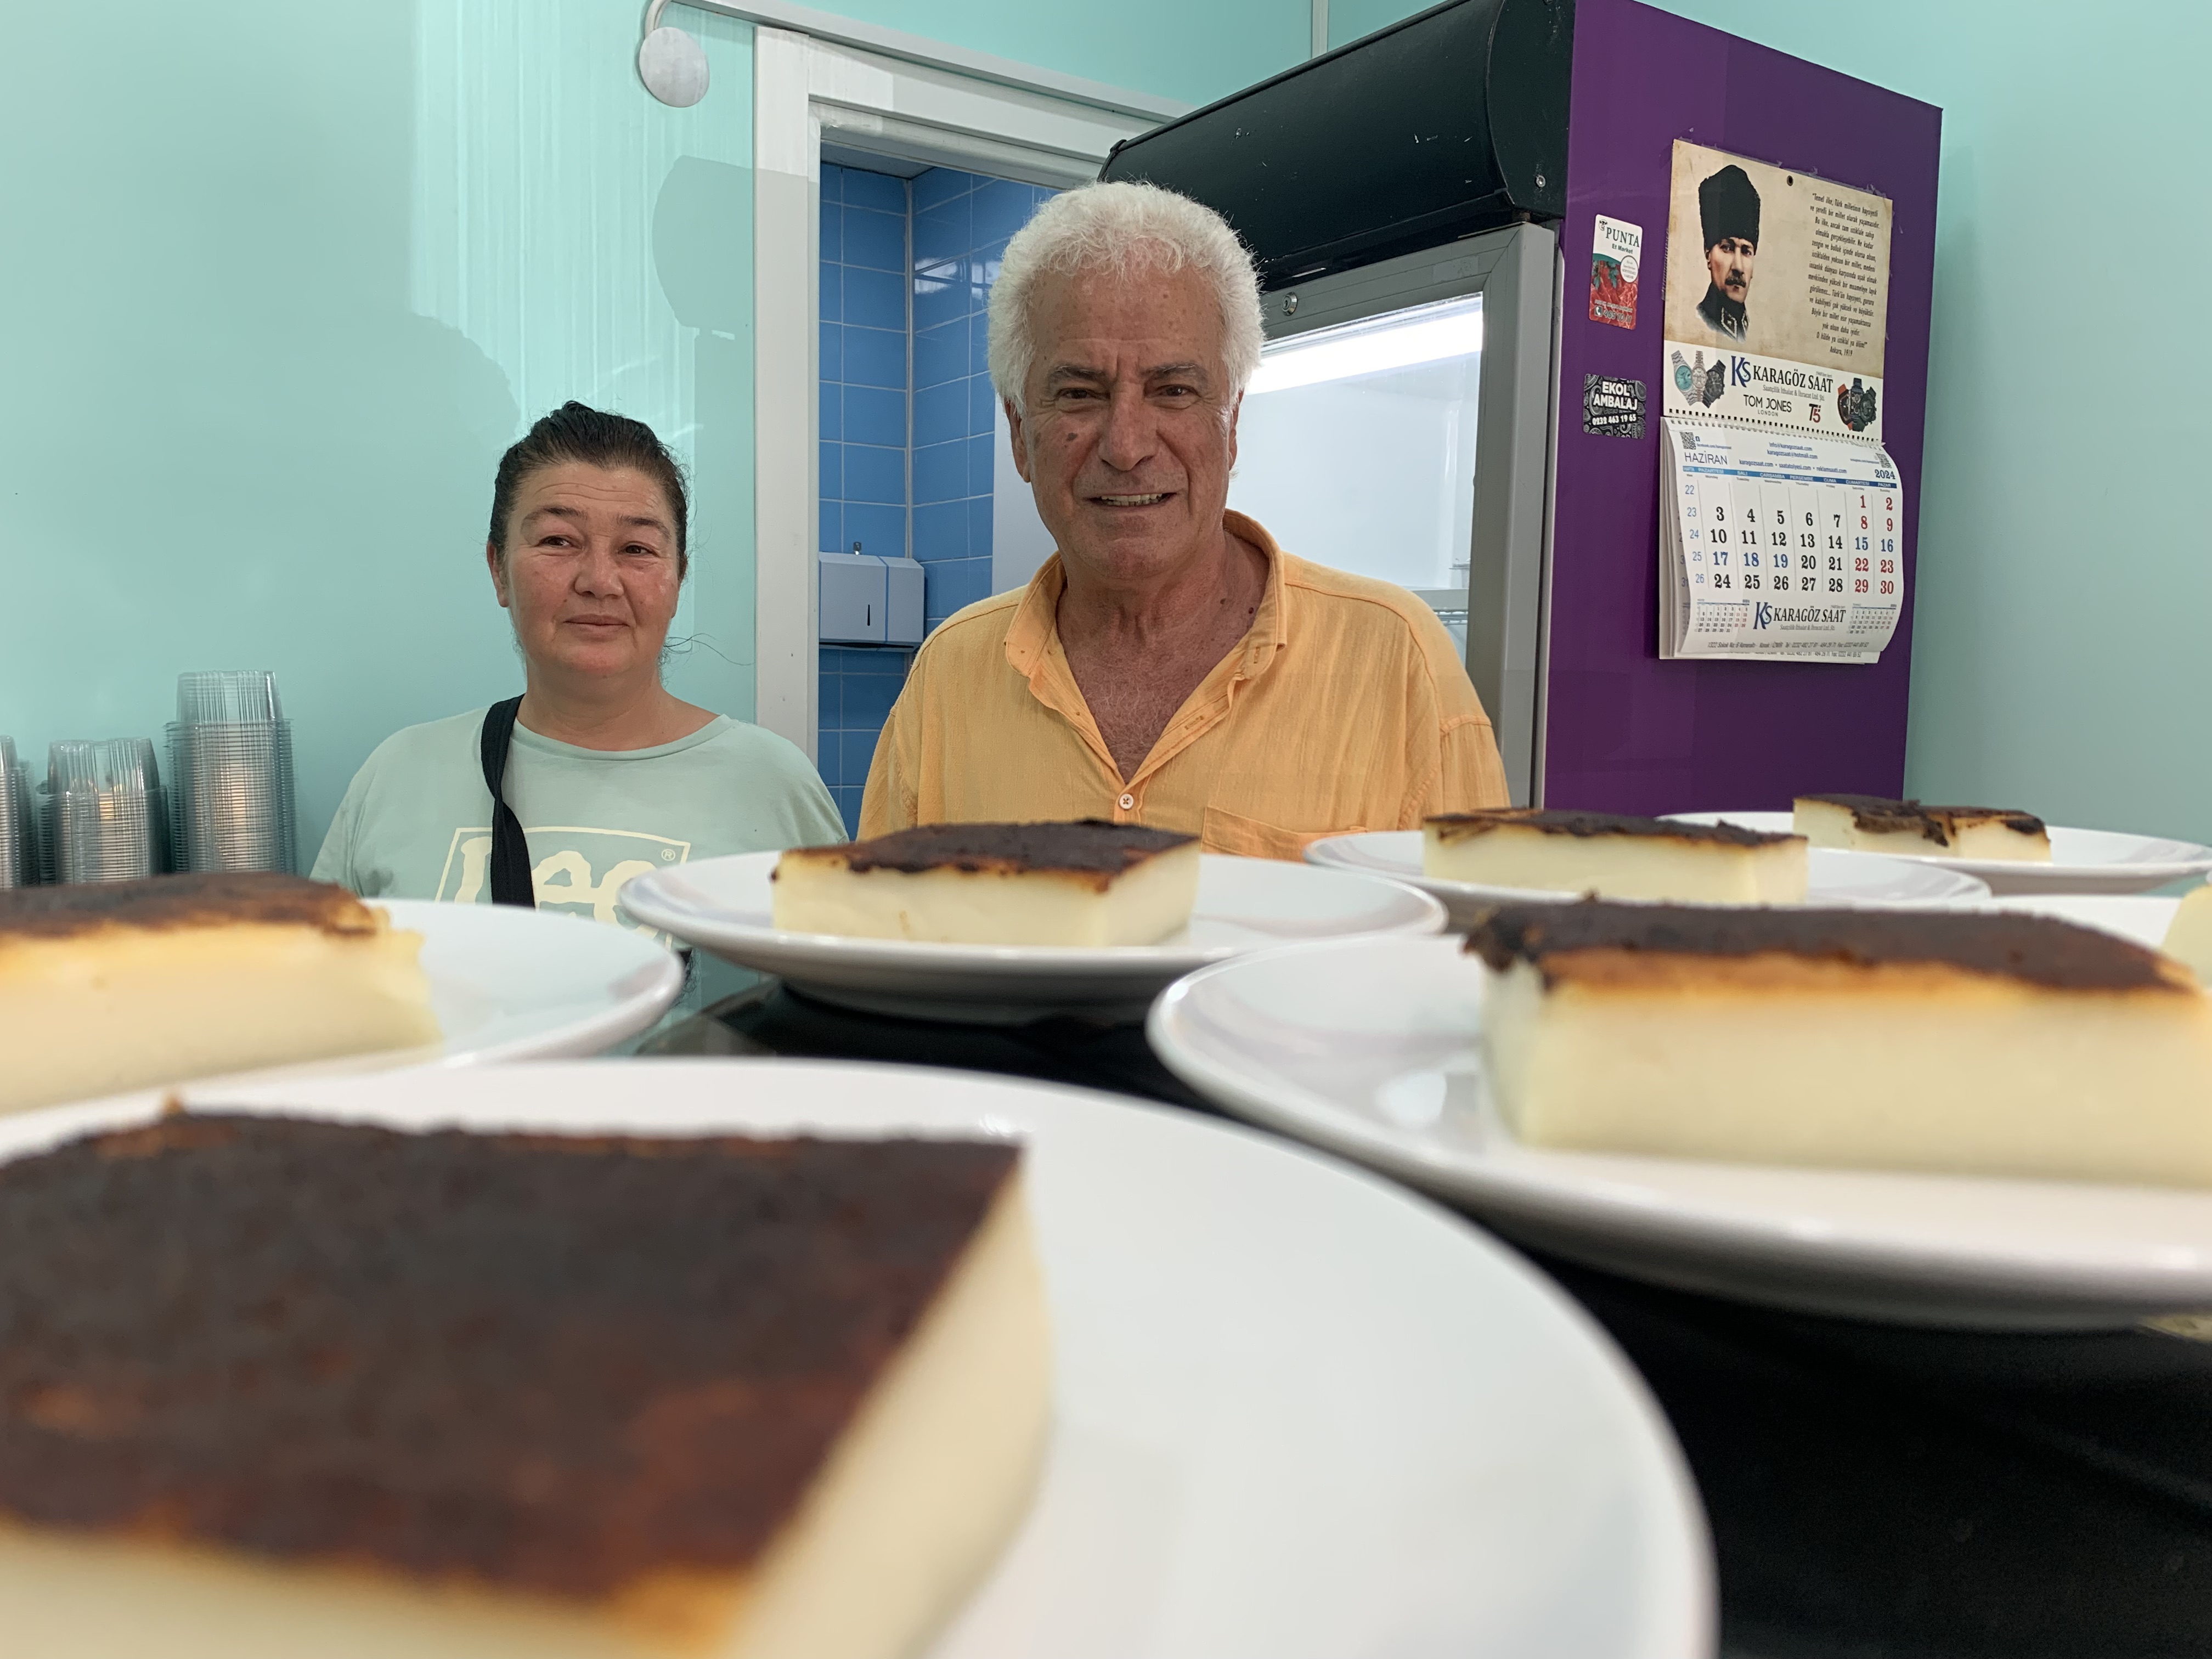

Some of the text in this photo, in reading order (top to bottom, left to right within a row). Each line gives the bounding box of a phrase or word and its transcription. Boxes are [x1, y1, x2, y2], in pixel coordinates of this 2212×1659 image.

[1606, 227, 1640, 248] PUNTA
[1618, 245, 1633, 254] Market
[1731, 356, 1833, 393] KS KARAGÖZ SAAT
[1602, 381, 1630, 396] EKOL
[1593, 394, 1638, 410] AMBALAJ
[1743, 394, 1792, 413] TOM JONES
[1592, 416, 1607, 425] 0232
[1608, 415, 1619, 424] 463
[1684, 450, 1728, 465] HAZİRAN
[1875, 469, 1896, 479] 2024
[1685, 485, 1893, 511] 22 1 2
[1687, 506, 1893, 532] 23 3 4 5 6 7 8 9
[1690, 529, 1699, 539] 24
[1710, 529, 1727, 543] 10
[1741, 530, 1757, 545] 11
[1771, 532, 1787, 546] 12
[1800, 534, 1815, 548] 13
[1829, 535, 1843, 549] 14
[1855, 537, 1869, 551] 15
[1881, 539, 1893, 552] 16
[1692, 551, 1702, 561] 25
[1713, 551, 1728, 566] 17
[1743, 552, 1759, 567] 18
[1773, 554, 1788, 568] 19
[1801, 555, 1816, 569] 20
[1829, 556, 1842, 571] 21
[1855, 557, 1869, 572] 22
[1880, 560, 1894, 573] 23
[1696, 573, 1894, 594] 26 24 25 26 27 28 29 30
[1753, 602, 1773, 629] KS
[1773, 606, 1821, 622] KARAGÖZ
[1822, 609, 1846, 623] SAAT
